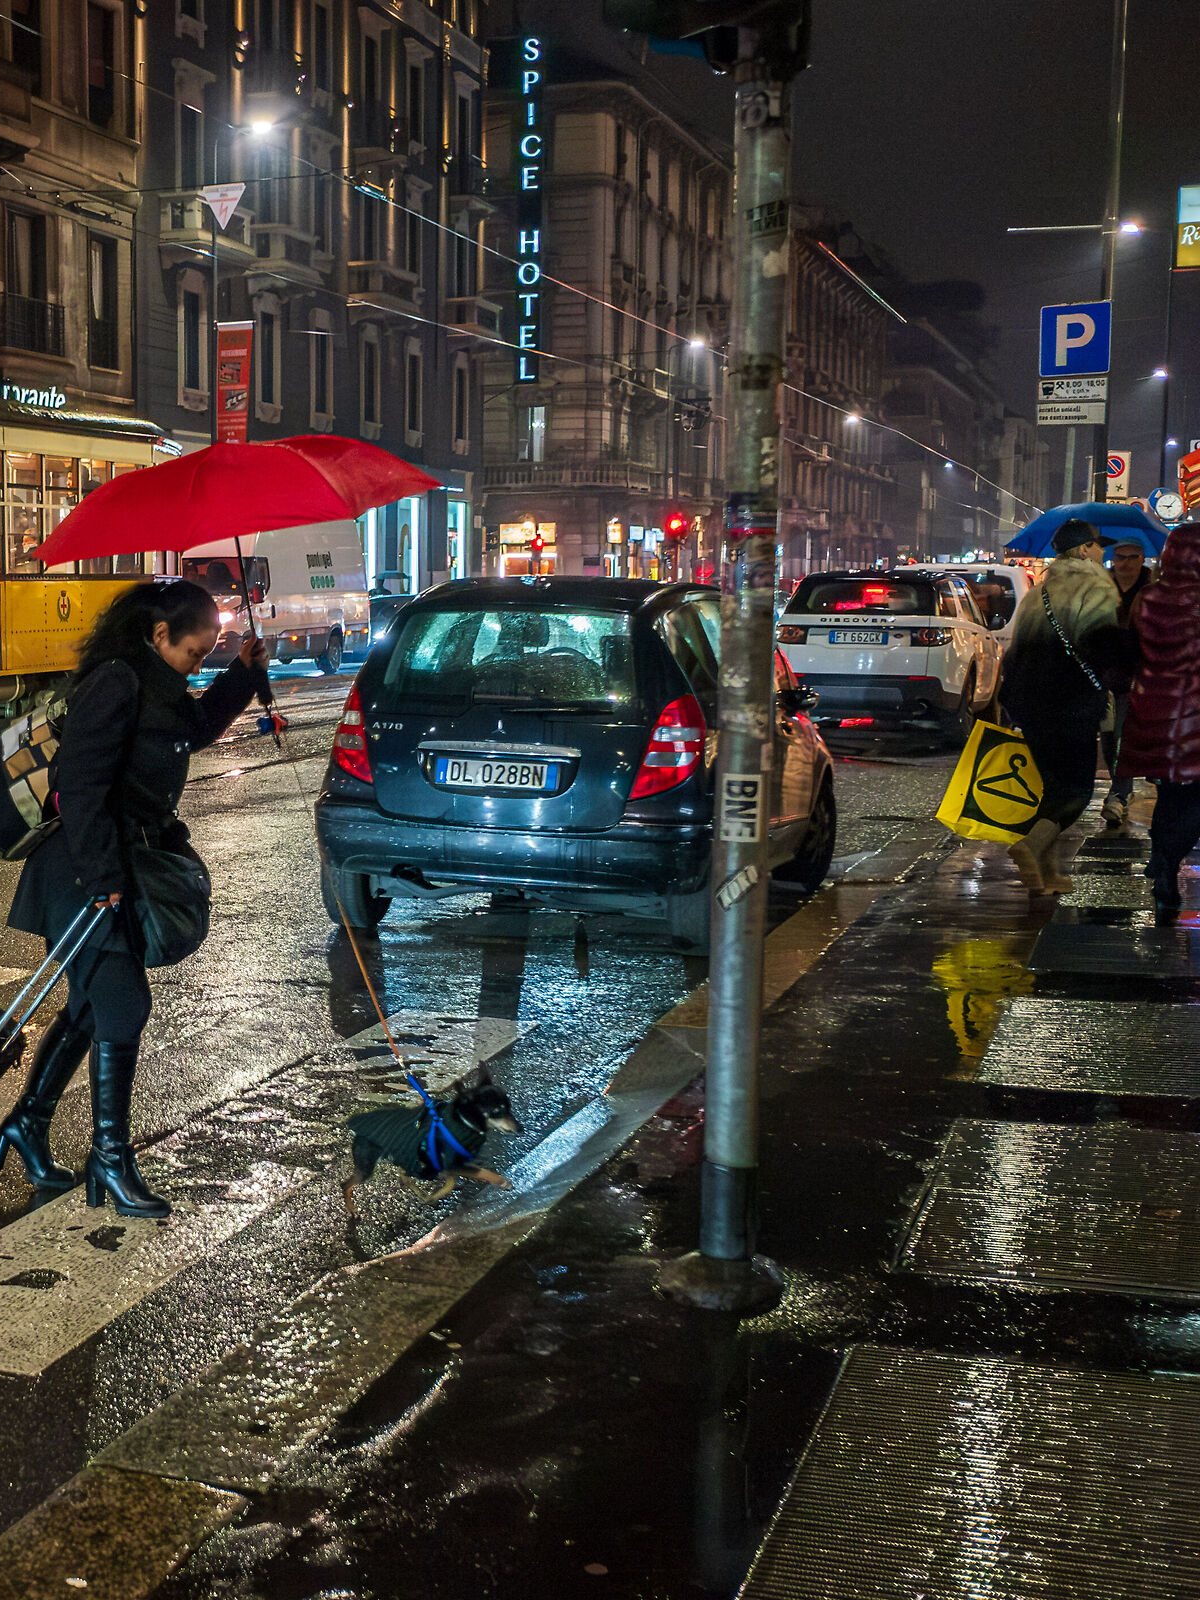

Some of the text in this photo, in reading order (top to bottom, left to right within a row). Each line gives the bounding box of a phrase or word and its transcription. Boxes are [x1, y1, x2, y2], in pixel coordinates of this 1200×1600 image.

[520, 38, 542, 190] SPICE
[517, 230, 541, 380] HOTEL
[1056, 313, 1095, 366] P
[450, 760, 546, 787] DL 028BN
